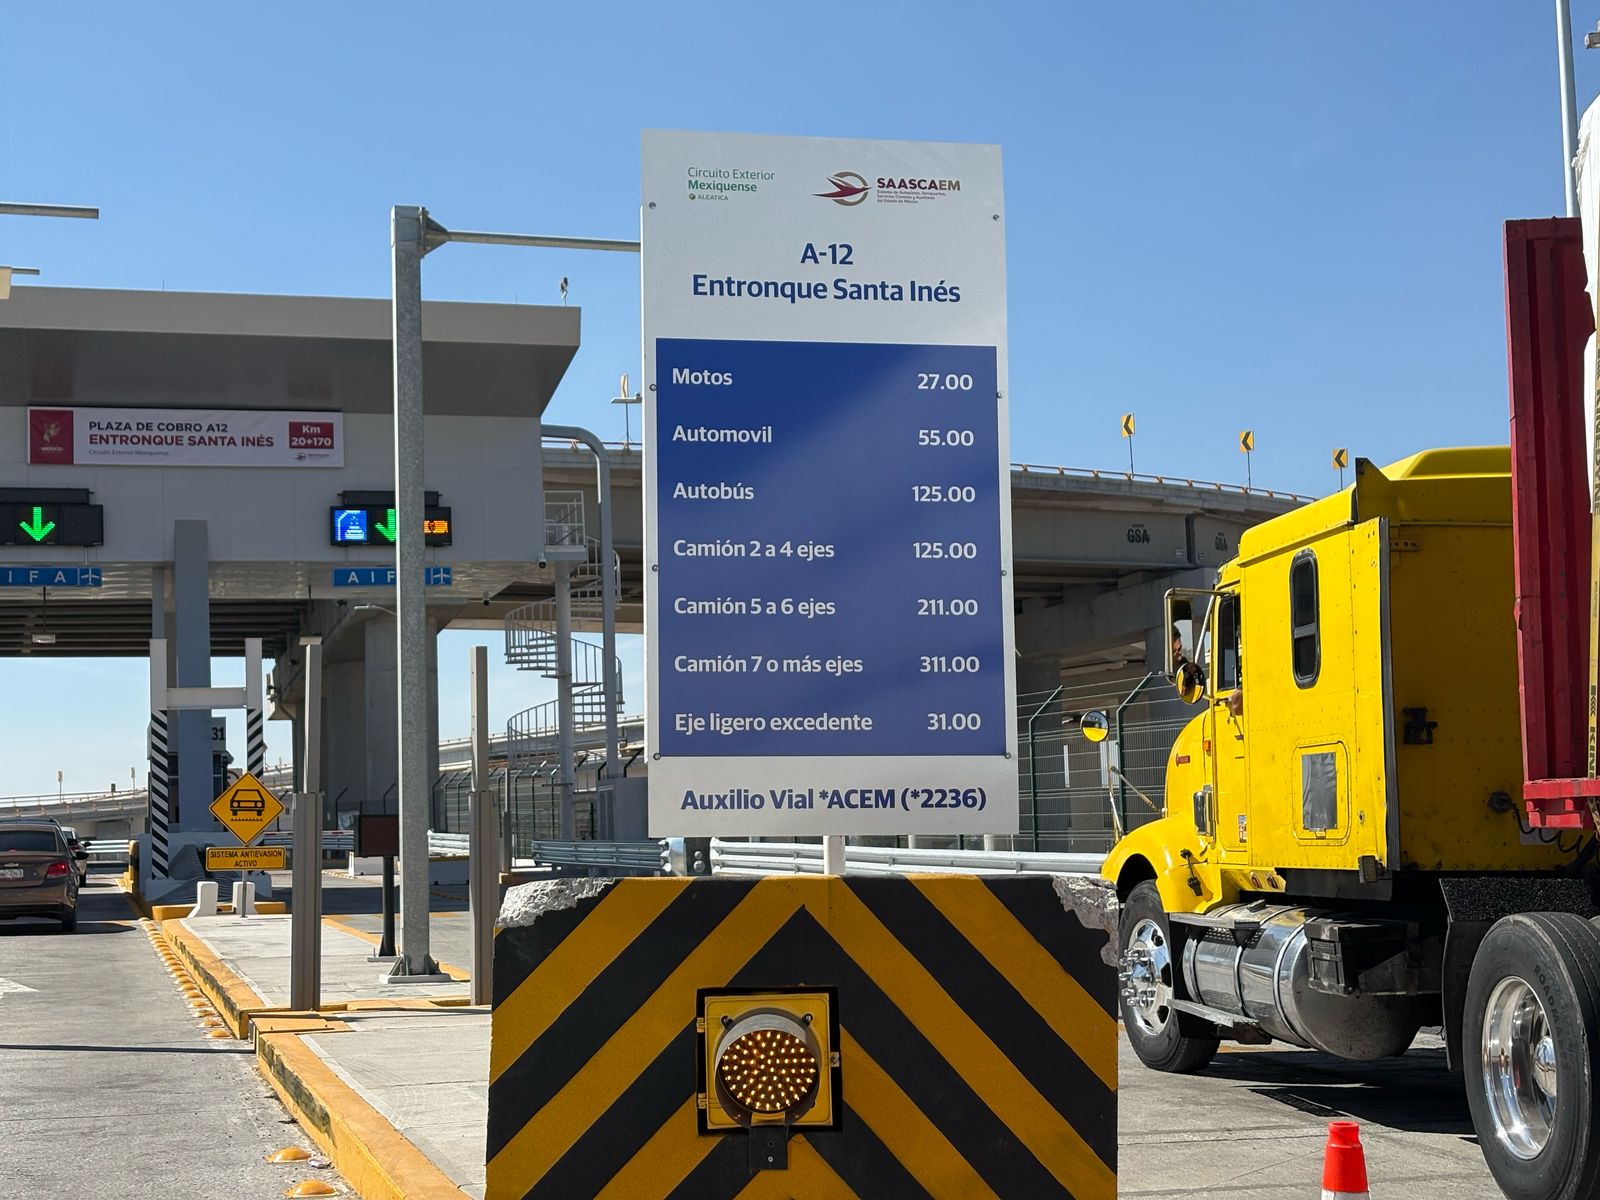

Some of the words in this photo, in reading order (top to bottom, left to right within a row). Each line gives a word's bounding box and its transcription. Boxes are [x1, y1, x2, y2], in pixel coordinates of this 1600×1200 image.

[688, 167, 730, 178] Circuito
[733, 169, 775, 180] Exterior
[688, 180, 757, 192] Mexiquense
[877, 178, 960, 191] SAASCAEM
[800, 243, 853, 265] A-12
[693, 274, 827, 303] Entronque
[833, 278, 902, 301] Santa
[910, 280, 960, 302] Inés
[672, 368, 732, 385] Motos
[917, 373, 973, 390] 27.00
[89, 421, 132, 431] PLAZA
[136, 422, 153, 431] DE
[157, 422, 202, 432] COBRO
[206, 423, 228, 432] A12
[302, 425, 320, 433] Km
[672, 425, 772, 443] Automovil
[89, 434, 184, 446] ENTRONQUE
[188, 435, 237, 447] SANTA
[241, 434, 274, 447] INÉS
[291, 437, 332, 446] 20+170
[918, 430, 974, 446] 55.00
[673, 482, 754, 500] Autobús
[912, 486, 976, 502] 125.00
[1127, 528, 1150, 544] GSA
[673, 539, 745, 557] Camión
[750, 541, 761, 557] 2
[765, 544, 776, 557] a
[780, 541, 793, 557] 4
[797, 541, 834, 561] ejes
[913, 542, 977, 559] 125.00
[348, 570, 396, 583] AIF
[674, 597, 746, 615] Camión
[750, 598, 762, 615] 5
[766, 601, 776, 615] a
[780, 598, 793, 615] 6
[798, 598, 836, 618] ejes
[917, 599, 978, 615] 211.00
[674, 655, 746, 672] Camión
[751, 656, 763, 672] 7
[766, 659, 778, 672] o
[783, 655, 821, 672] más
[825, 656, 863, 676] ejes
[920, 656, 980, 673] 311.00
[675, 713, 705, 735] Eje
[710, 712, 765, 735] ligero
[770, 713, 873, 731] excedente
[927, 713, 981, 730] 31.00
[681, 789, 765, 810] Auxilio
[770, 788, 813, 809] Vial
[210, 850, 239, 858] SISTEMA
